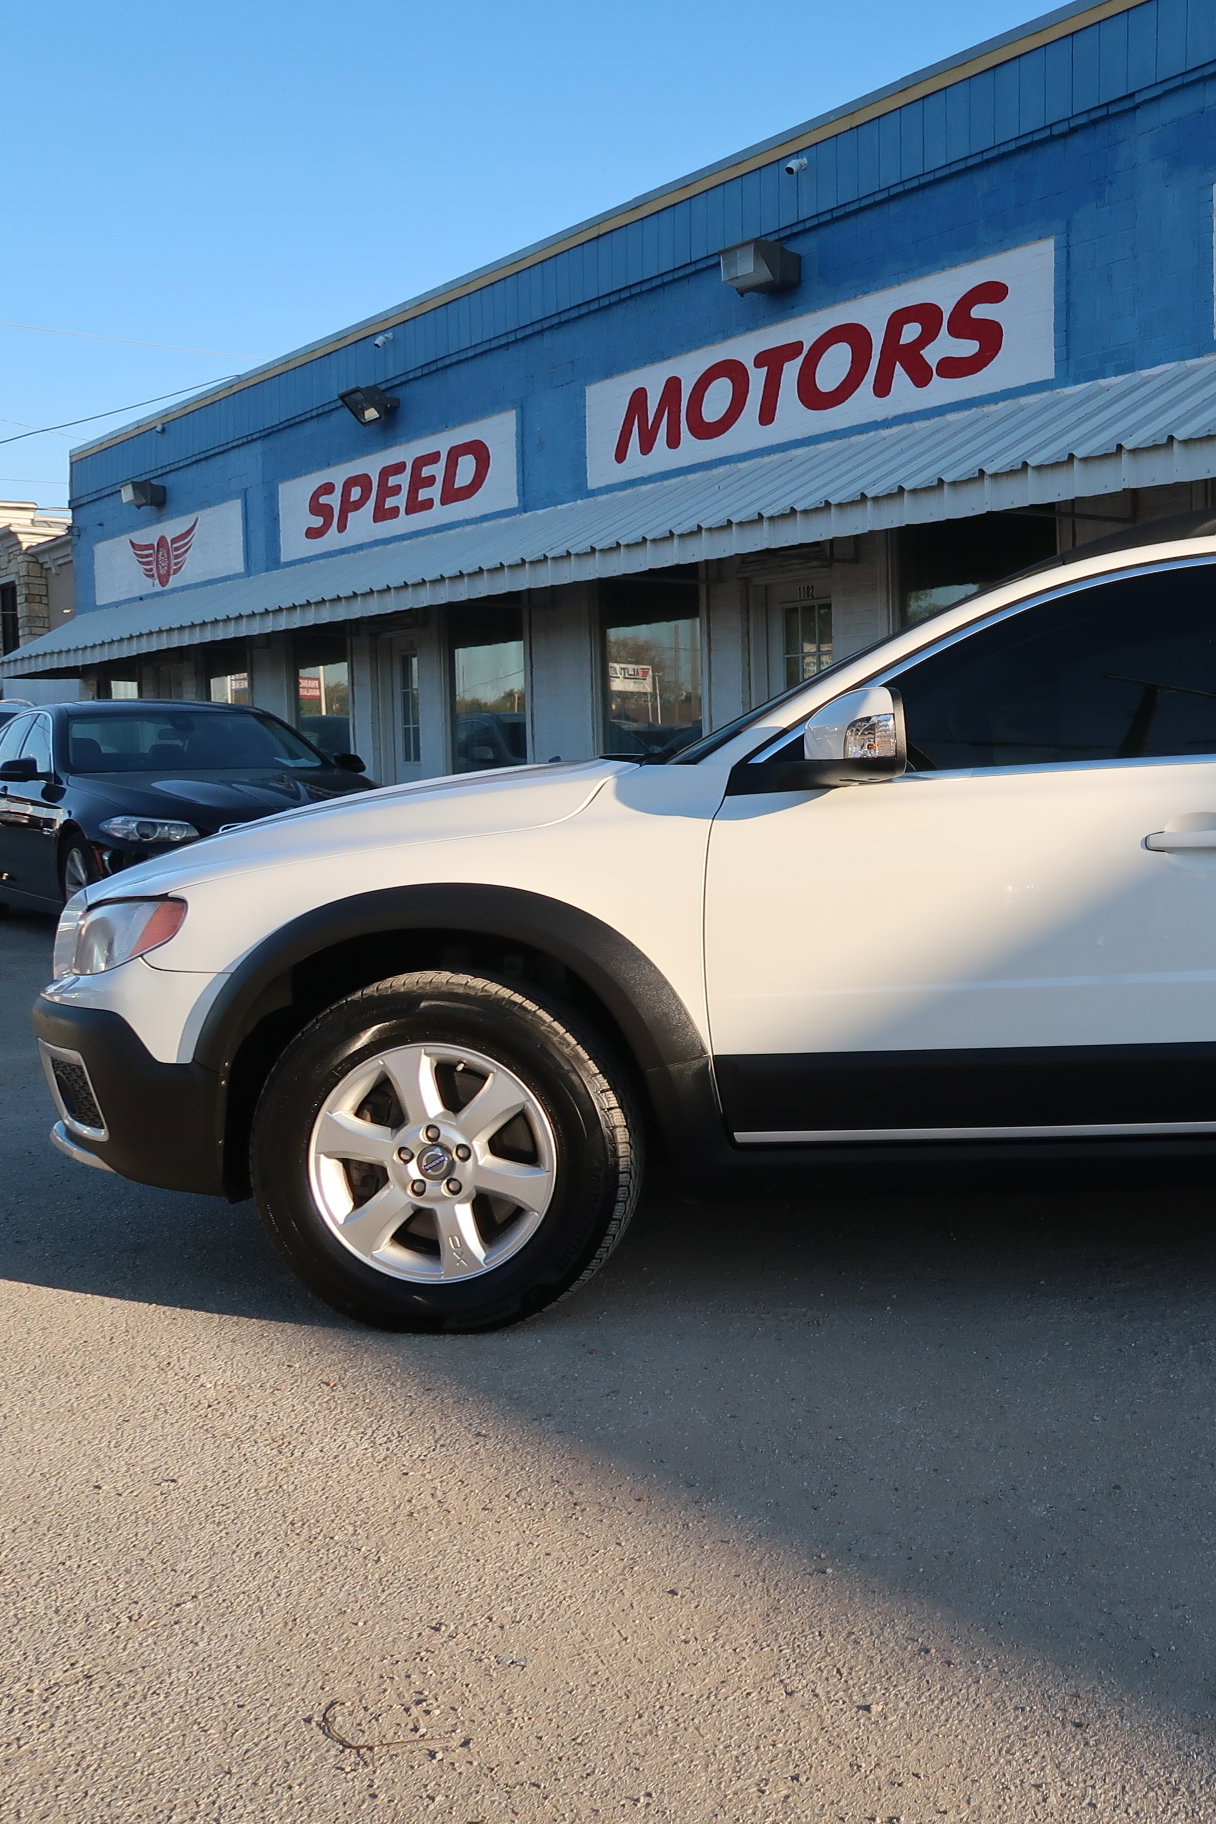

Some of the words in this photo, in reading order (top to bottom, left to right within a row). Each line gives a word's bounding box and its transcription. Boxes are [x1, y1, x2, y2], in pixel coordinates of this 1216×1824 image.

[615, 281, 1008, 463] MOTORS
[305, 440, 489, 539] SPEED
[798, 584, 815, 600] 1102
